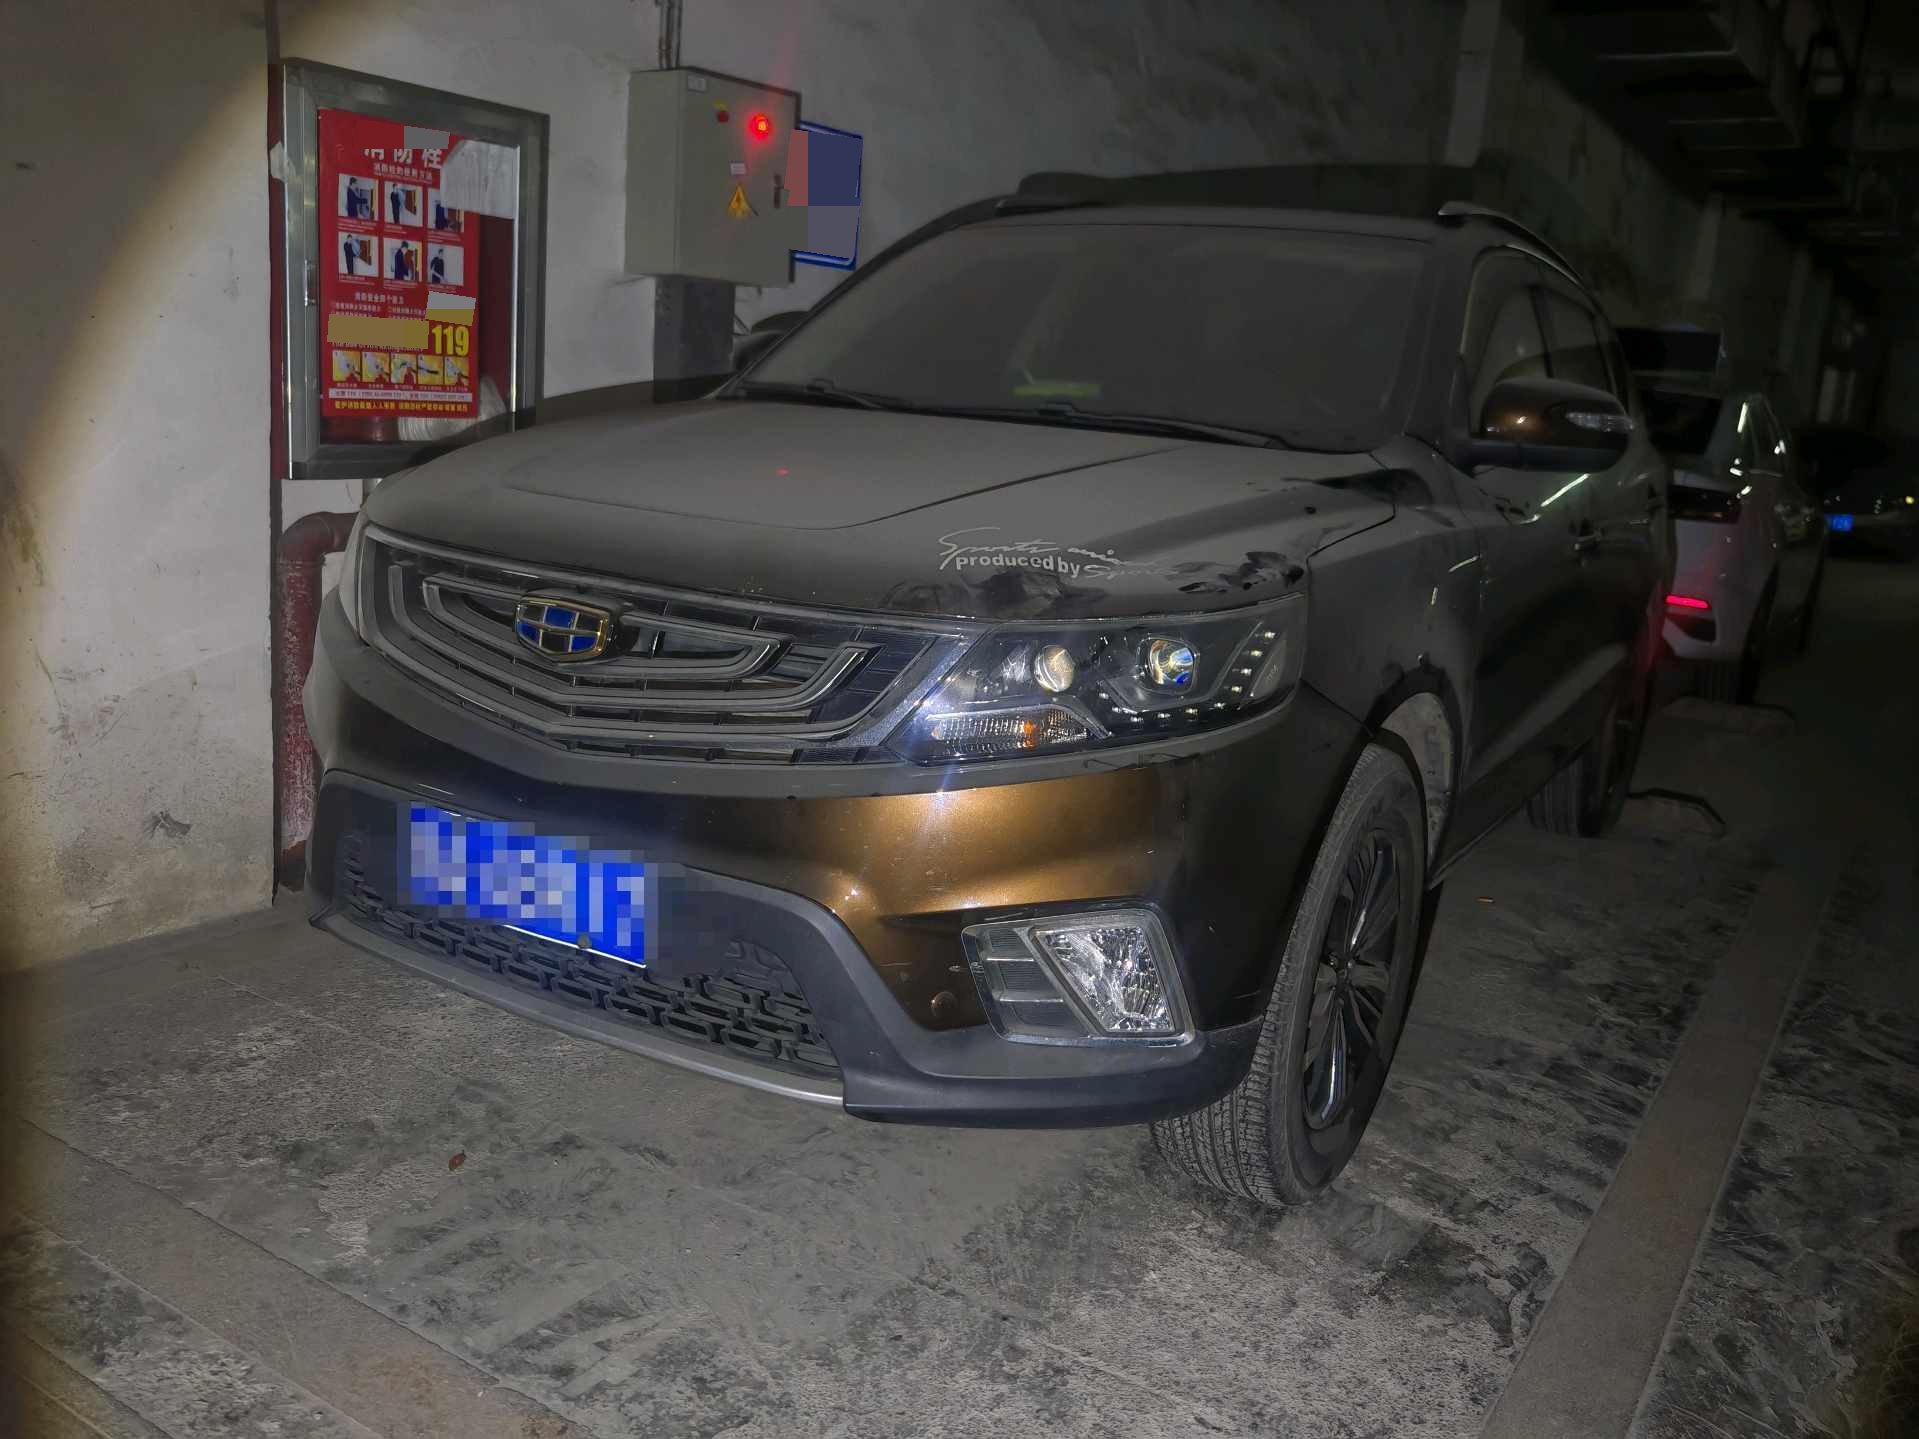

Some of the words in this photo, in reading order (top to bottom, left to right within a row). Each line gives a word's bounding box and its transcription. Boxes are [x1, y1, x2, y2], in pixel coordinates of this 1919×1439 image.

[432, 325, 469, 356] 119
[956, 554, 1053, 571] produced
[1057, 556, 1080, 578] by
